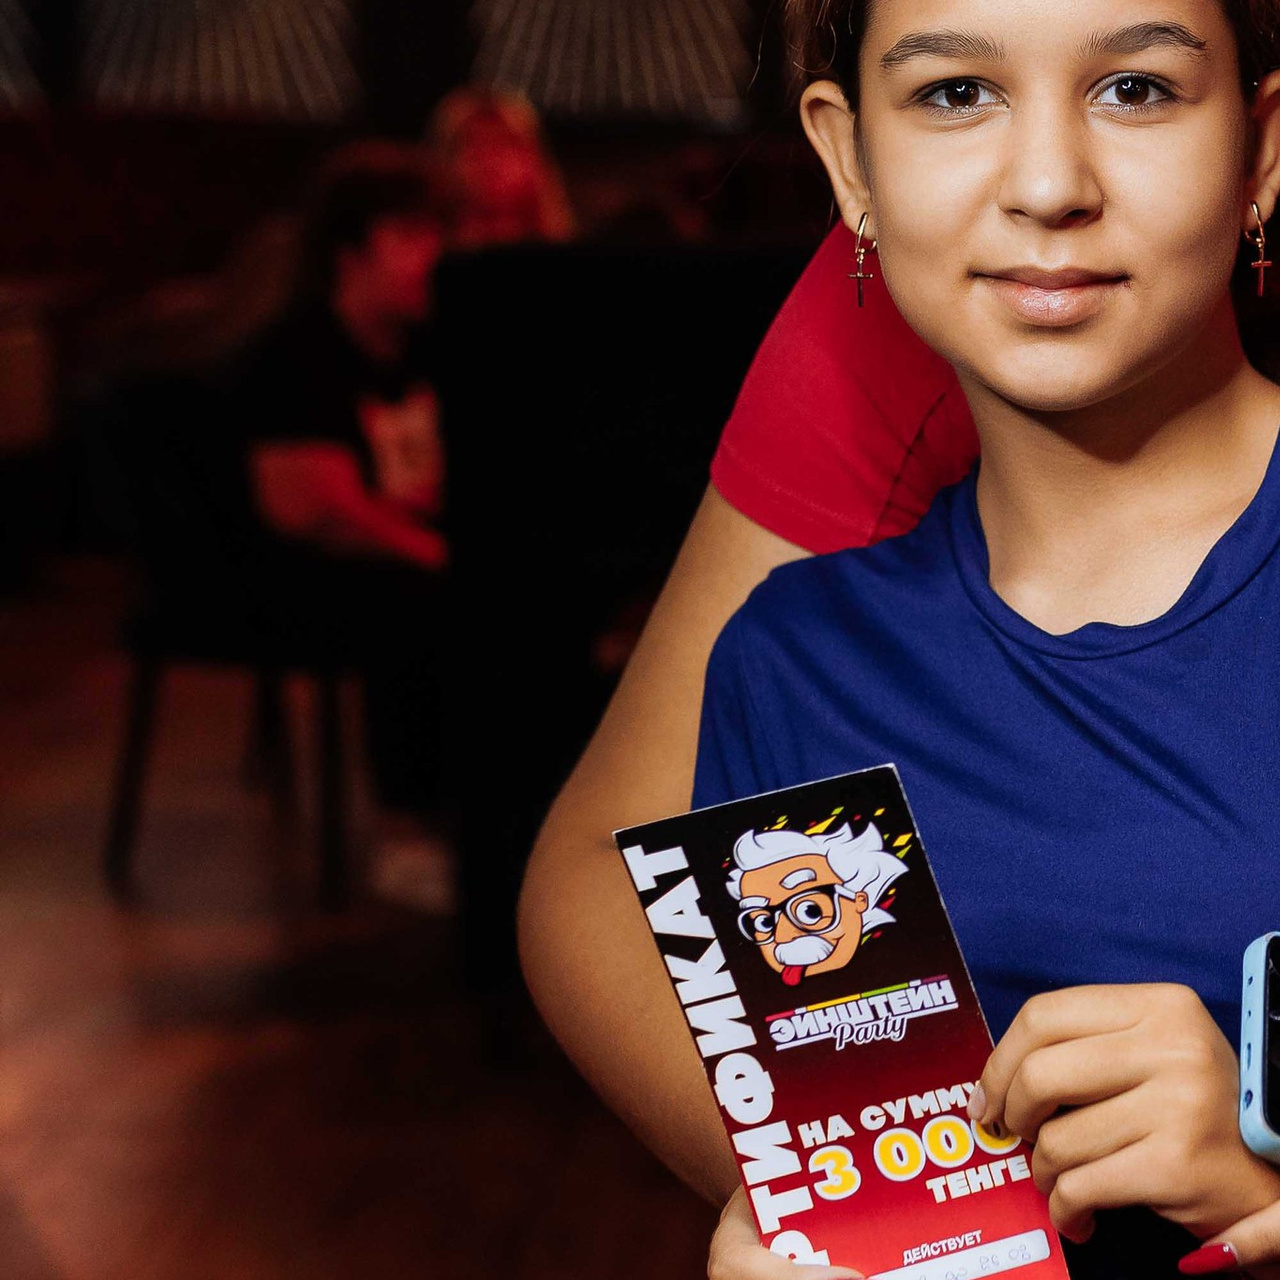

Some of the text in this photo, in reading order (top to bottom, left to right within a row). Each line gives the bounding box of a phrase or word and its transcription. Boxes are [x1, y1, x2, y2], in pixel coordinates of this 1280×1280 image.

[768, 978, 958, 1044] ЭЙНШТЕЙН
[832, 1015, 908, 1051] Party
[797, 1114, 856, 1150] НА
[808, 1145, 862, 1201] 3
[925, 1154, 1032, 1204] ТЕНГЕ
[903, 1230, 983, 1266] ДЕЙСТВУЕТ
